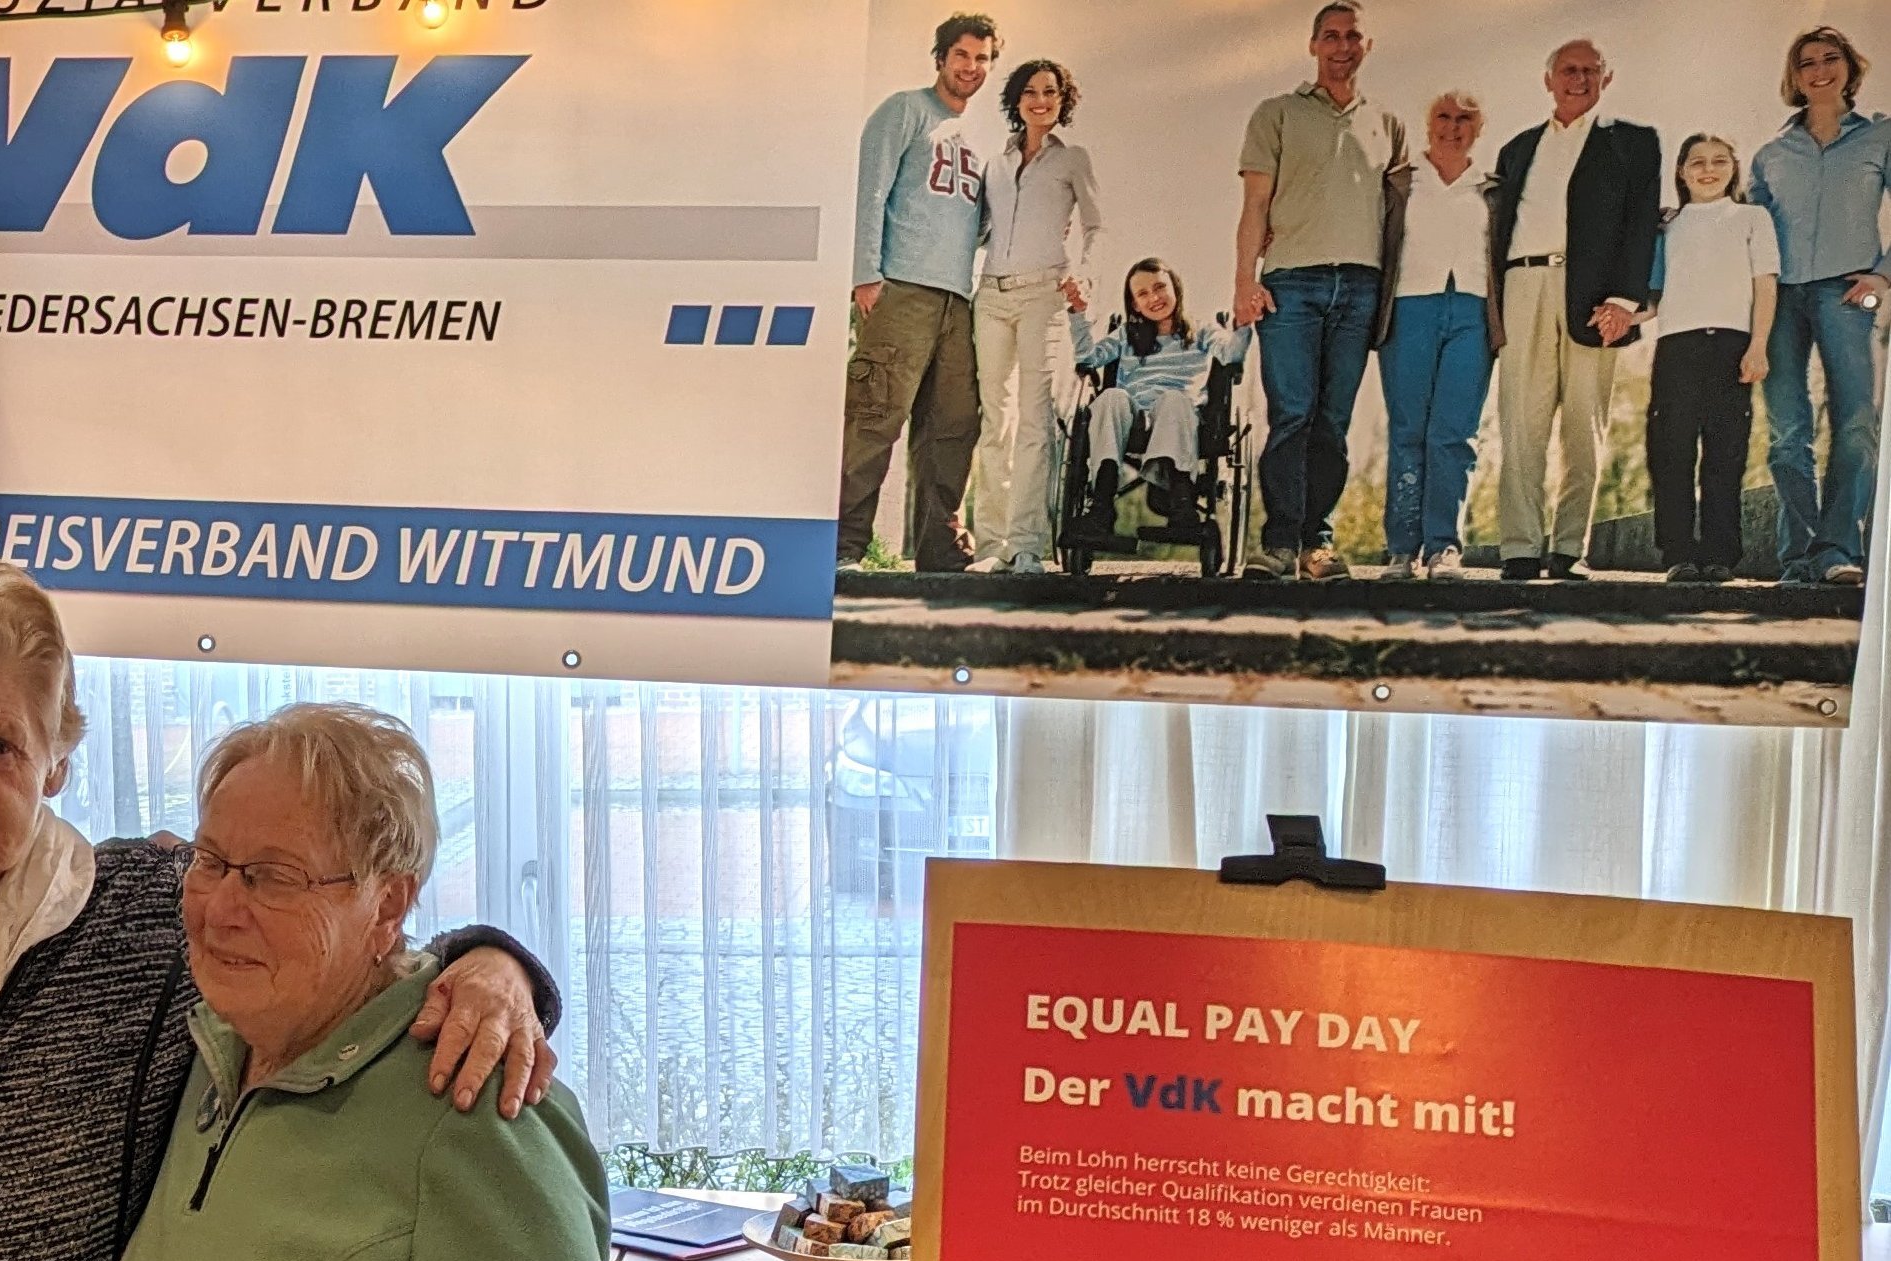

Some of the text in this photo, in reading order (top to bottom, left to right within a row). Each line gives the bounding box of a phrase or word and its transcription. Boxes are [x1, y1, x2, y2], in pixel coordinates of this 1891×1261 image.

[399, 527, 767, 596] WITTMUND
[1026, 994, 1420, 1054] EQUAL PAY DAY
[1023, 1067, 1516, 1139] Der VdK macht mit!
[1018, 1170, 1484, 1223] Trotz gleicher Qualifikation verdienen Frauen
[1019, 1145, 1431, 1194] Beim Lohn herrscht keine Gerechtigkeit:
[1017, 1195, 1451, 1247] im Durchschnitt 18 % weniger als Männer.
